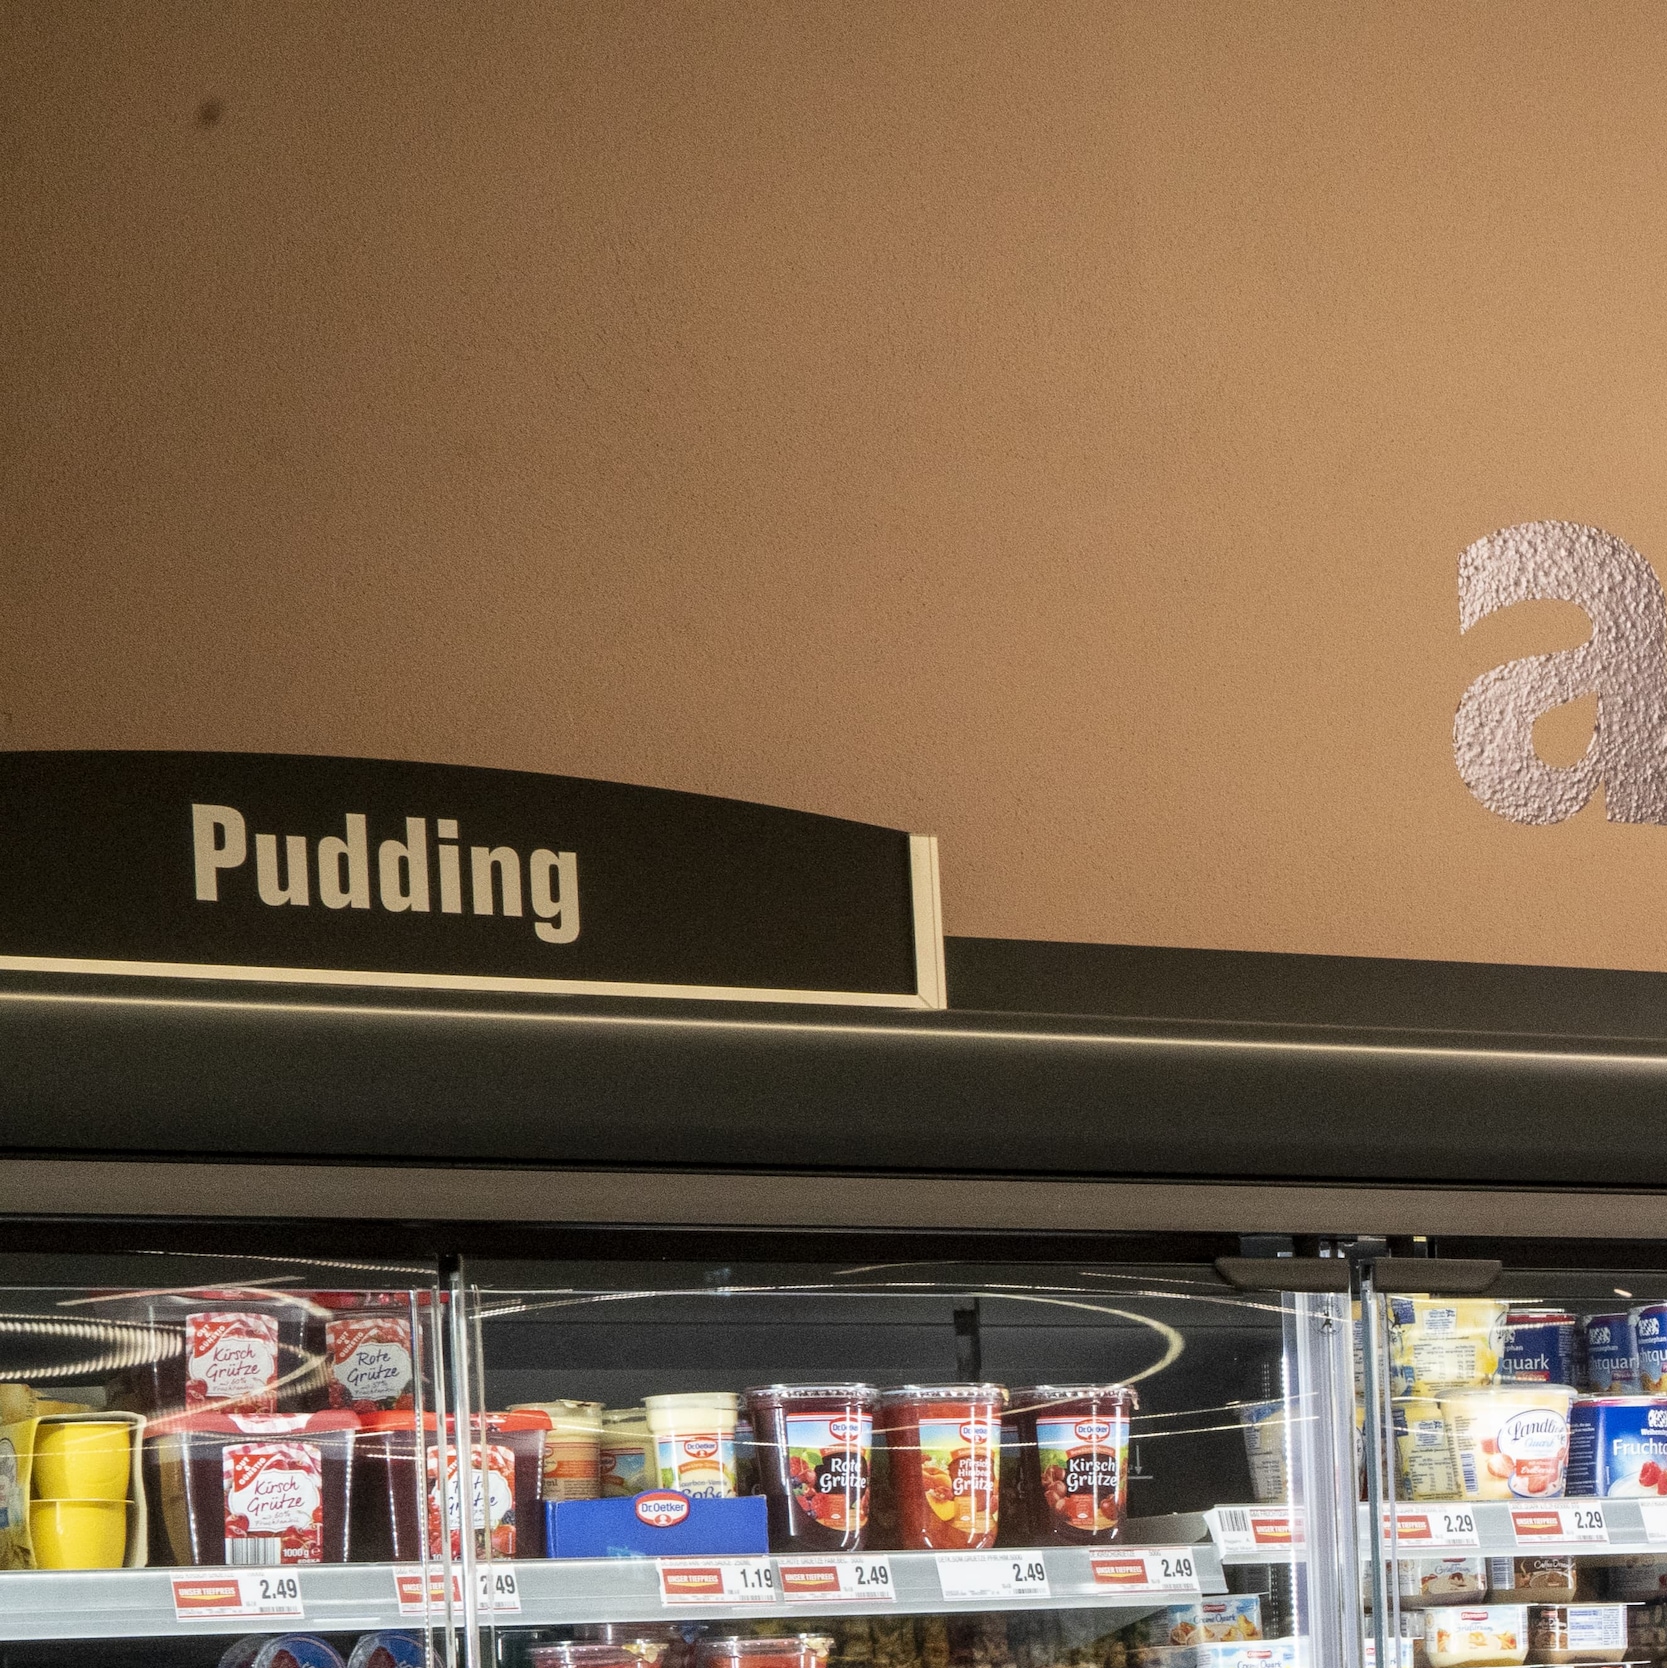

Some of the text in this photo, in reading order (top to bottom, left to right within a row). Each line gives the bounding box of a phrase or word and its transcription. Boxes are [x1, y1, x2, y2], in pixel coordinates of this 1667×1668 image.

[192, 803, 581, 944] Pudding
[831, 1457, 862, 1474] Rote
[1068, 1458, 1116, 1476] Kirsch
[255, 1477, 300, 1494] Kirsch
[819, 1471, 867, 1493] Grütze
[1066, 1472, 1119, 1493] Grütze
[246, 1492, 306, 1514] Grütze
[1443, 1513, 1474, 1535] 2.29
[1574, 1510, 1604, 1530] 2.29
[854, 1564, 889, 1586] 2.49
[1012, 1561, 1046, 1582] 2.49
[1161, 1558, 1193, 1578] 2.49
[259, 1578, 298, 1600] 2.49
[740, 1569, 773, 1589] 1.19
[178, 1585, 236, 1599] UNSER TIEFPREIS
